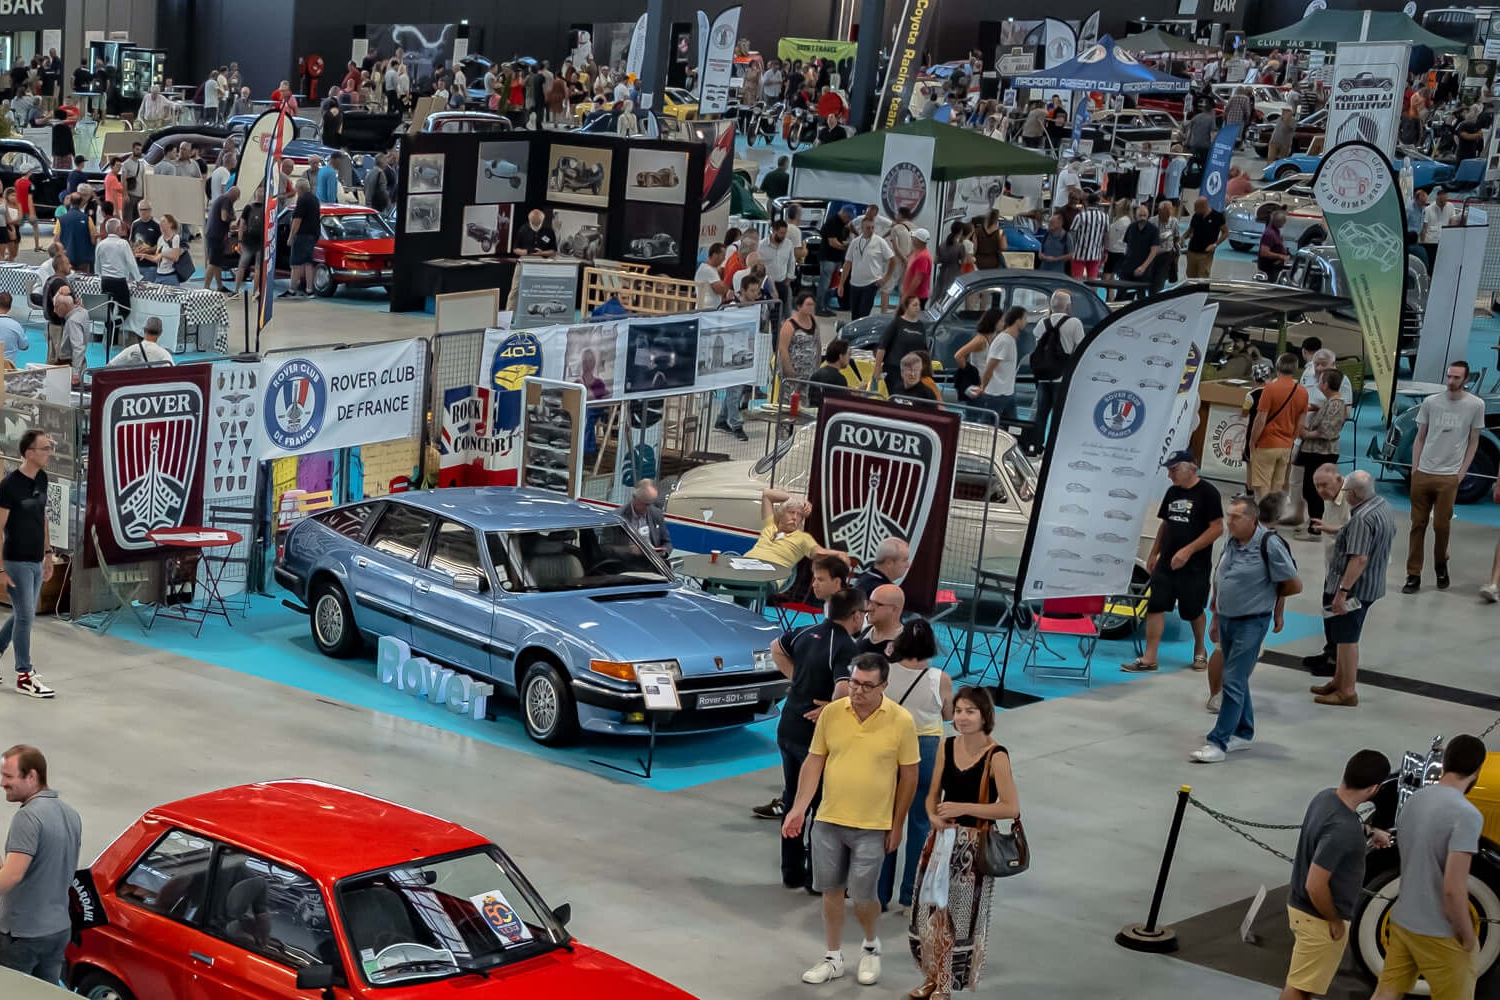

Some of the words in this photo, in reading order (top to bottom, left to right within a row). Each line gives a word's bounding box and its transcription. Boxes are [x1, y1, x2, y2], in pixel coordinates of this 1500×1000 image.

[0, 0, 43, 15] BAR
[1213, 0, 1235, 12] BAR
[907, 0, 929, 45] Coyote
[1257, 39, 1281, 47] CLUB
[892, 49, 916, 93] Racing
[1015, 77, 1057, 87] MACADAM
[1059, 79, 1098, 89] PASSION
[1099, 81, 1120, 91] CLUB
[1151, 82, 1174, 91] PASSION
[1175, 82, 1190, 91] CLUB
[500, 345, 536, 357] 403
[273, 363, 298, 389] ROVER
[300, 364, 320, 383] CLUB
[330, 371, 377, 393] ROVER
[380, 366, 415, 385] CLUB
[121, 394, 191, 417] ROVER
[337, 404, 353, 422] DE
[357, 395, 409, 418] FRANCE
[452, 399, 481, 425] ROCK
[273, 430, 284, 443] DE
[284, 426, 316, 447] FRANCE
[838, 423, 921, 455] ROVER
[377, 635, 494, 720] Rover
